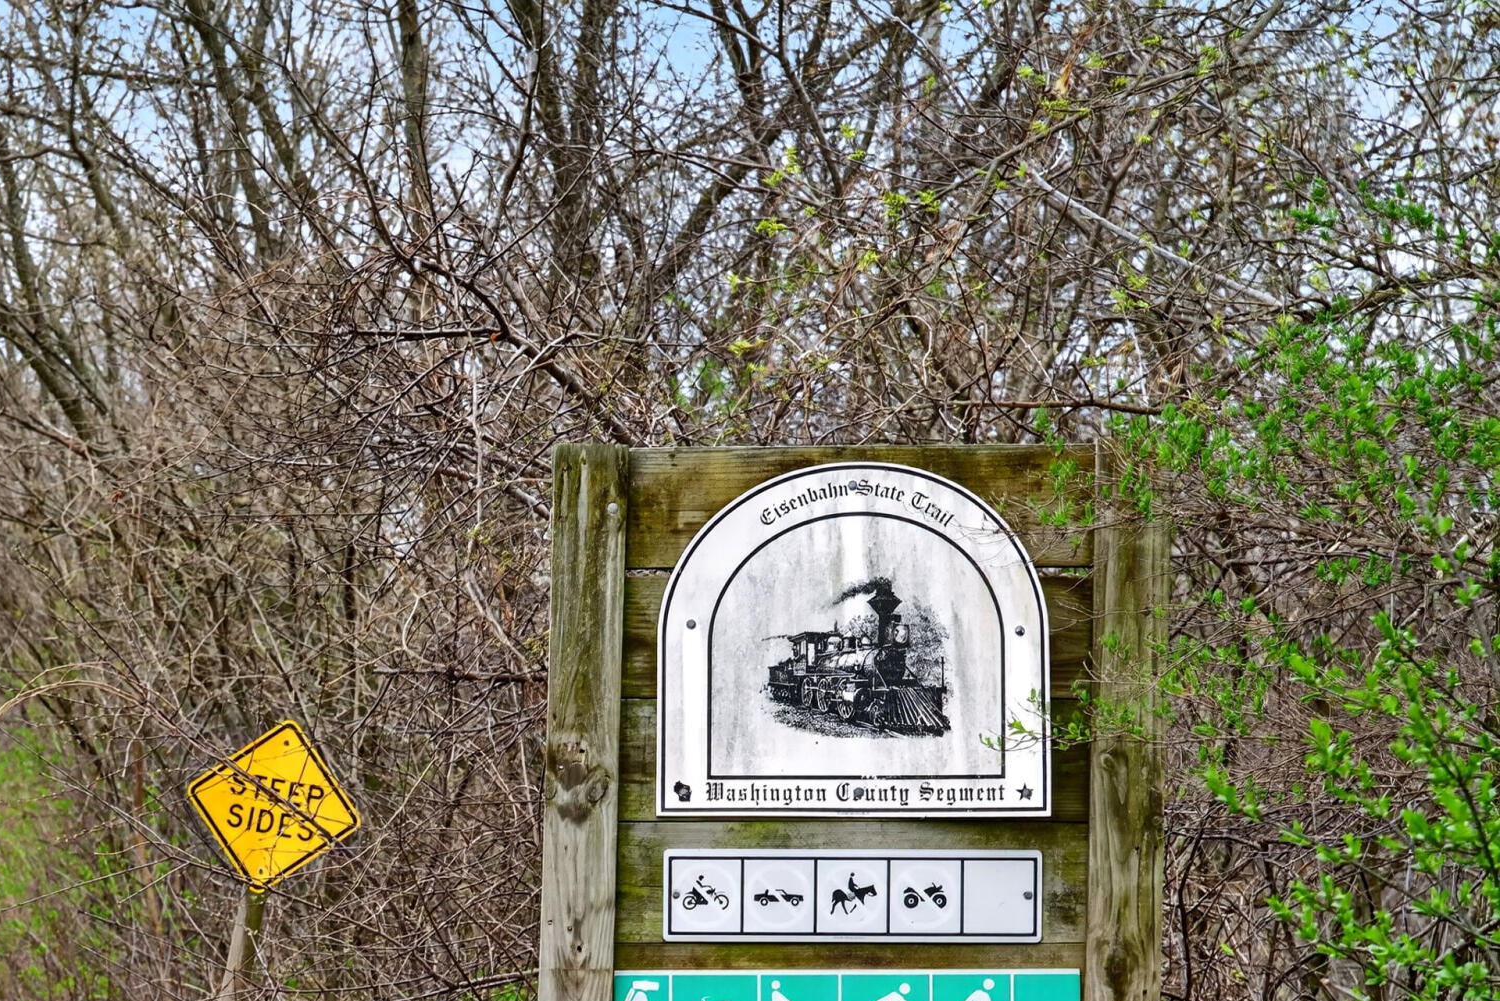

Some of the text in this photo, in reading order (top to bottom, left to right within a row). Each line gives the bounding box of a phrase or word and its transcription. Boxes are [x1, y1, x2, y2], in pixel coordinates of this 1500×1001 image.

[760, 479, 954, 527] Eisenbahn State Trail
[230, 773, 325, 807] STEEP
[706, 782, 826, 805] Washington
[919, 782, 1006, 805] Segment
